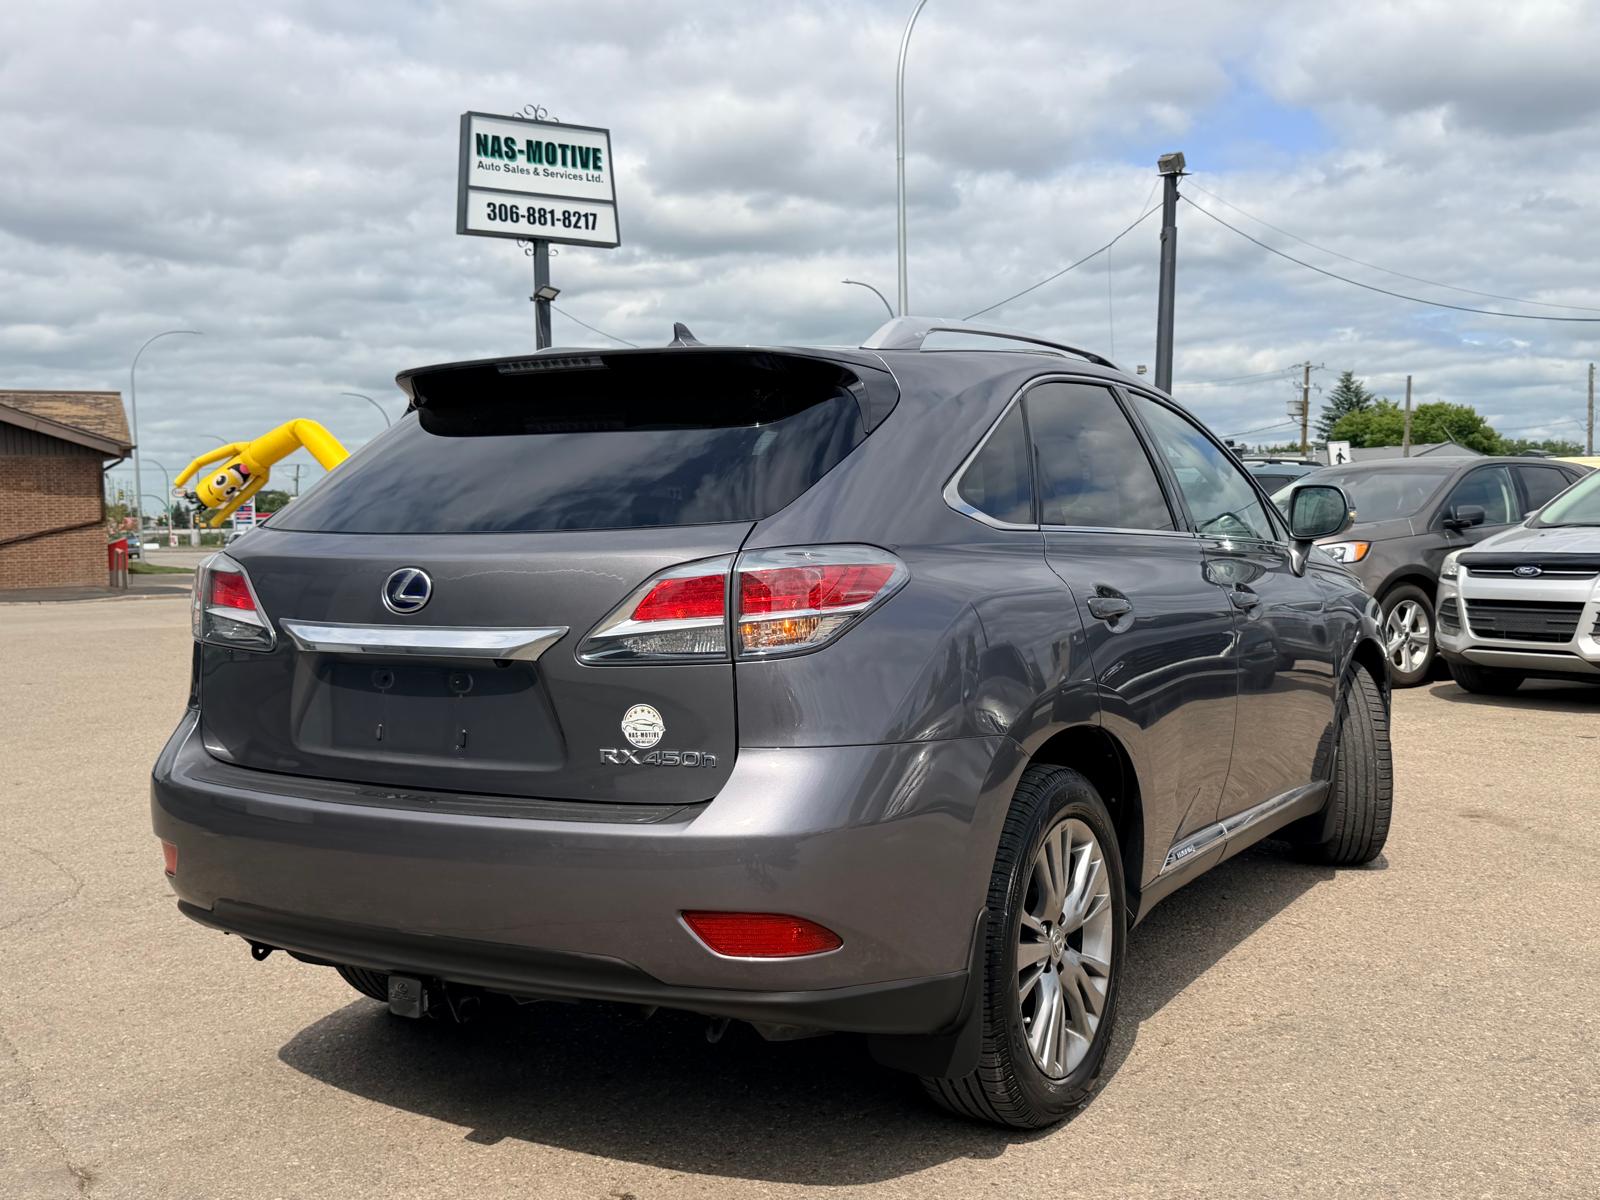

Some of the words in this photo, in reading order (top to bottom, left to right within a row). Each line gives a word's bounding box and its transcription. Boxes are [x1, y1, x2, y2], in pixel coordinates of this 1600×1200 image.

[475, 133, 603, 172] NAS-MOTIVE
[477, 160, 501, 172] Auto
[503, 163, 531, 176] Sales
[532, 167, 540, 176] &
[542, 168, 583, 181] Services
[586, 173, 604, 183] Ltd.
[486, 202, 597, 231] 306-881-8217
